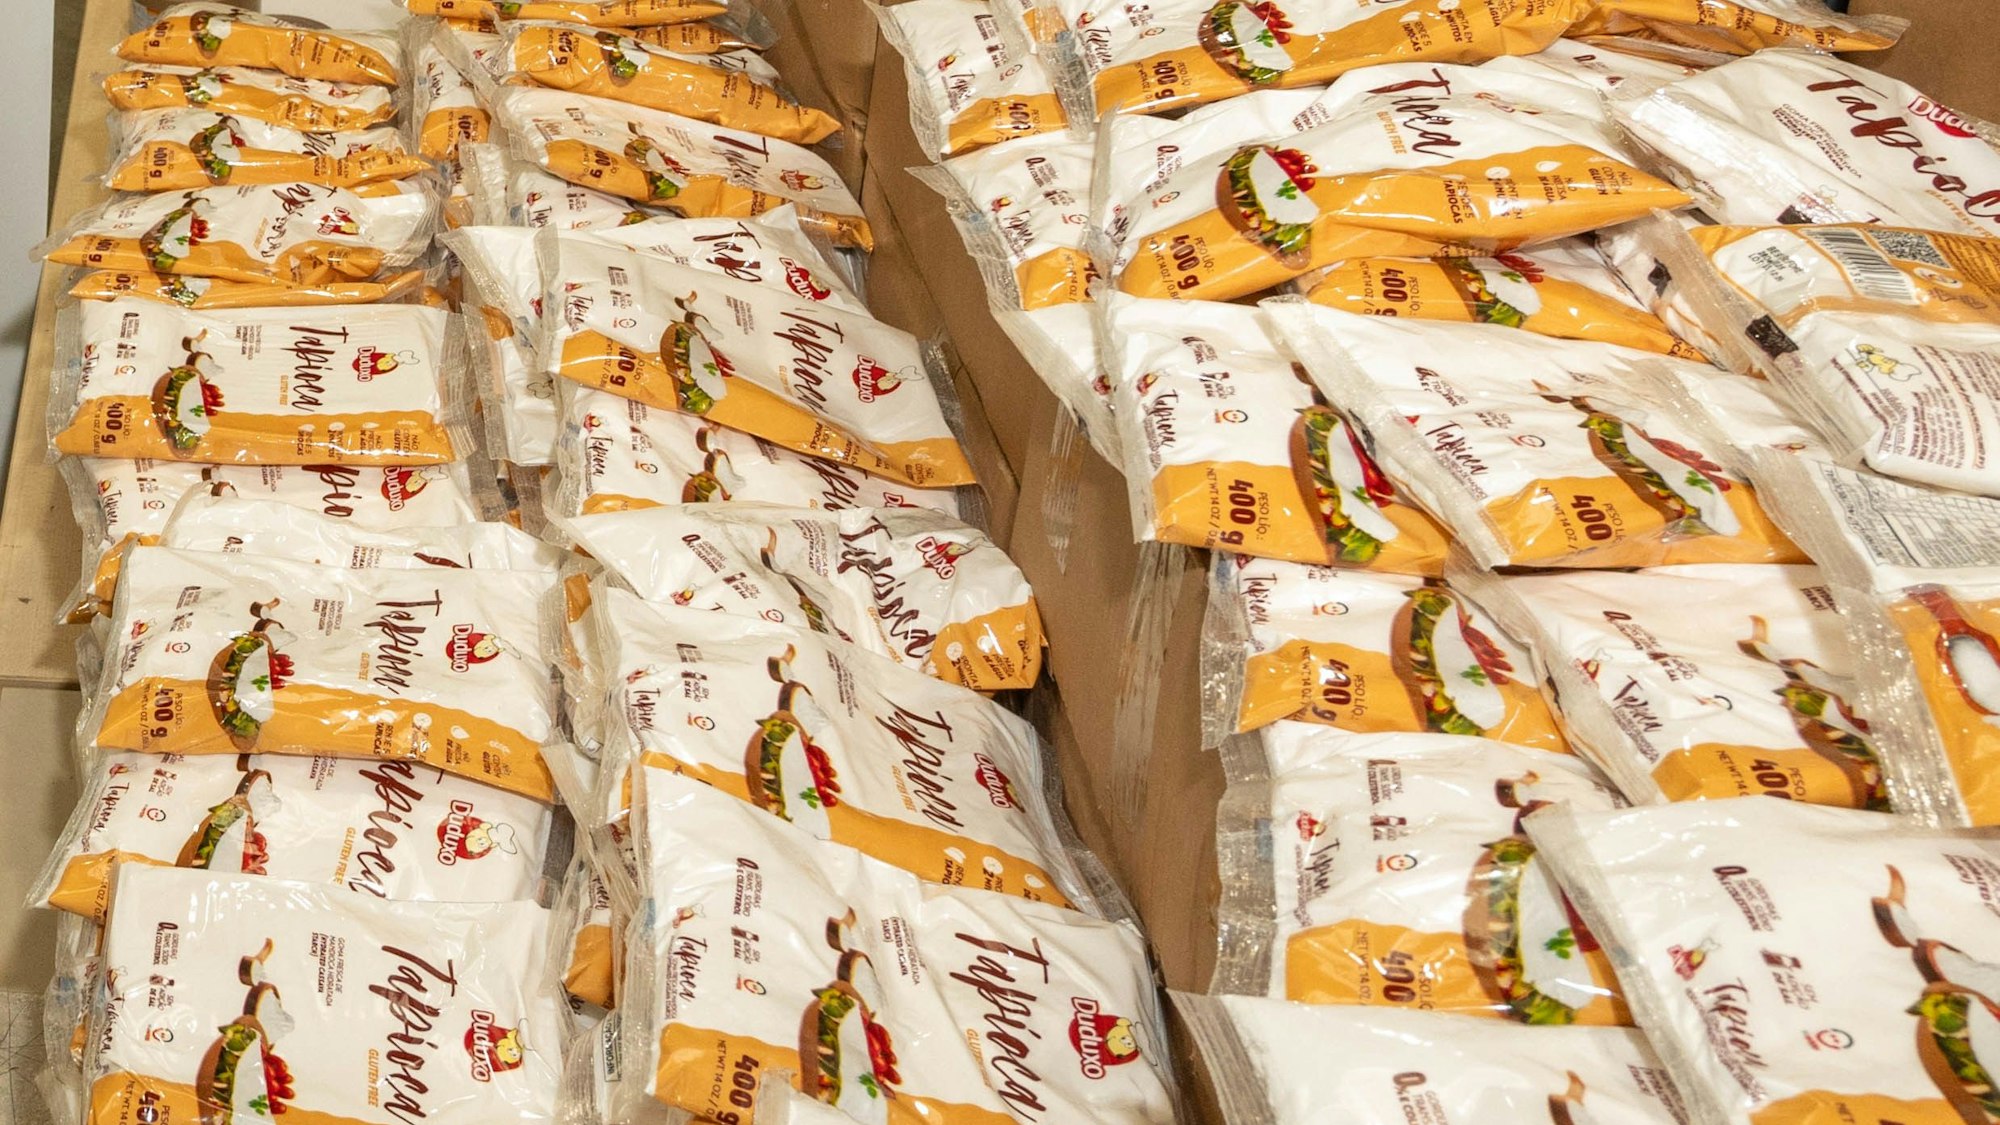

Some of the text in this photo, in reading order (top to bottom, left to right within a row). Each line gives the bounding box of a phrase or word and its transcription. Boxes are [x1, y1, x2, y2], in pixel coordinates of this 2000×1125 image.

[1463, 31, 1474, 44] EM
[555, 57, 568, 66] g
[1153, 60, 1179, 100] 400 g
[150, 147, 168, 179] 400 g
[1388, 134, 1406, 155] FREE
[589, 169, 603, 179] g
[1443, 180, 1464, 224] TAPIOCAS
[89, 253, 105, 263] g
[1168, 235, 1202, 290] 400 g
[1193, 237, 1209, 256] PESO
[1067, 285, 1079, 297] OZ
[1363, 287, 1374, 298] OZ
[1380, 269, 1409, 302] 400
[1408, 276, 1421, 294] PESO
[280, 326, 349, 412] Tapioca
[358, 346, 377, 382] Duduxo
[609, 374, 627, 386] g
[774, 312, 845, 414] Tapioca
[858, 355, 877, 403] Duduxo
[102, 402, 123, 444] 400 g
[1149, 388, 1180, 447] Tapioca
[591, 436, 613, 478] Tapioca
[1425, 420, 1489, 476] Tapioca
[383, 467, 405, 512] Duduxo
[1206, 467, 1221, 520] NET WT 14 OZ
[1257, 491, 1269, 515] PESO
[1551, 503, 1565, 517] WT
[1219, 480, 1257, 546] 400 g
[1559, 518, 1577, 543] 14 OZ
[1570, 495, 1613, 541] 400
[1602, 503, 1623, 527] PESO
[1240, 573, 1278, 626] Tapioca
[363, 589, 443, 694] Tapioca
[451, 623, 475, 673] Duduxo
[684, 690, 692, 700] SAL
[1302, 677, 1313, 687] 14
[1352, 674, 1366, 696] PESO
[150, 689, 174, 739] 400 g
[1312, 709, 1338, 721] g
[974, 752, 1012, 810] Duduxo
[1787, 767, 1806, 797] PESO
[92, 783, 130, 833] Tapioca
[348, 760, 444, 898] apioca
[438, 800, 475, 866] Duduxo
[333, 827, 358, 885] GLUTEN FREE
[941, 858, 954, 885] TAPIO
[309, 932, 319, 957] STARCH)
[1357, 931, 1369, 952] NET
[326, 935, 336, 1007] MANDIOCA HIDRATADA
[335, 937, 345, 994] GOMA FRESCA DE
[673, 935, 709, 1003] Tapioca
[1382, 952, 1416, 1003] 400
[148, 988, 158, 1007] DE SAL
[157, 988, 167, 1010] ADIÇÃO
[166, 995, 175, 1007] SEM
[100, 993, 125, 1054] Tapioca
[368, 945, 458, 1125] Tapioca
[949, 933, 1050, 1123] Tapioca
[1071, 996, 1107, 1080] Duduxo
[471, 1009, 494, 1083] Duduxo
[368, 1049, 379, 1108] GLUTEN FREE
[709, 1040, 727, 1099] NET WT 14 OZ
[729, 1055, 761, 1109] 400
[1835, 1101, 1857, 1124] NET
